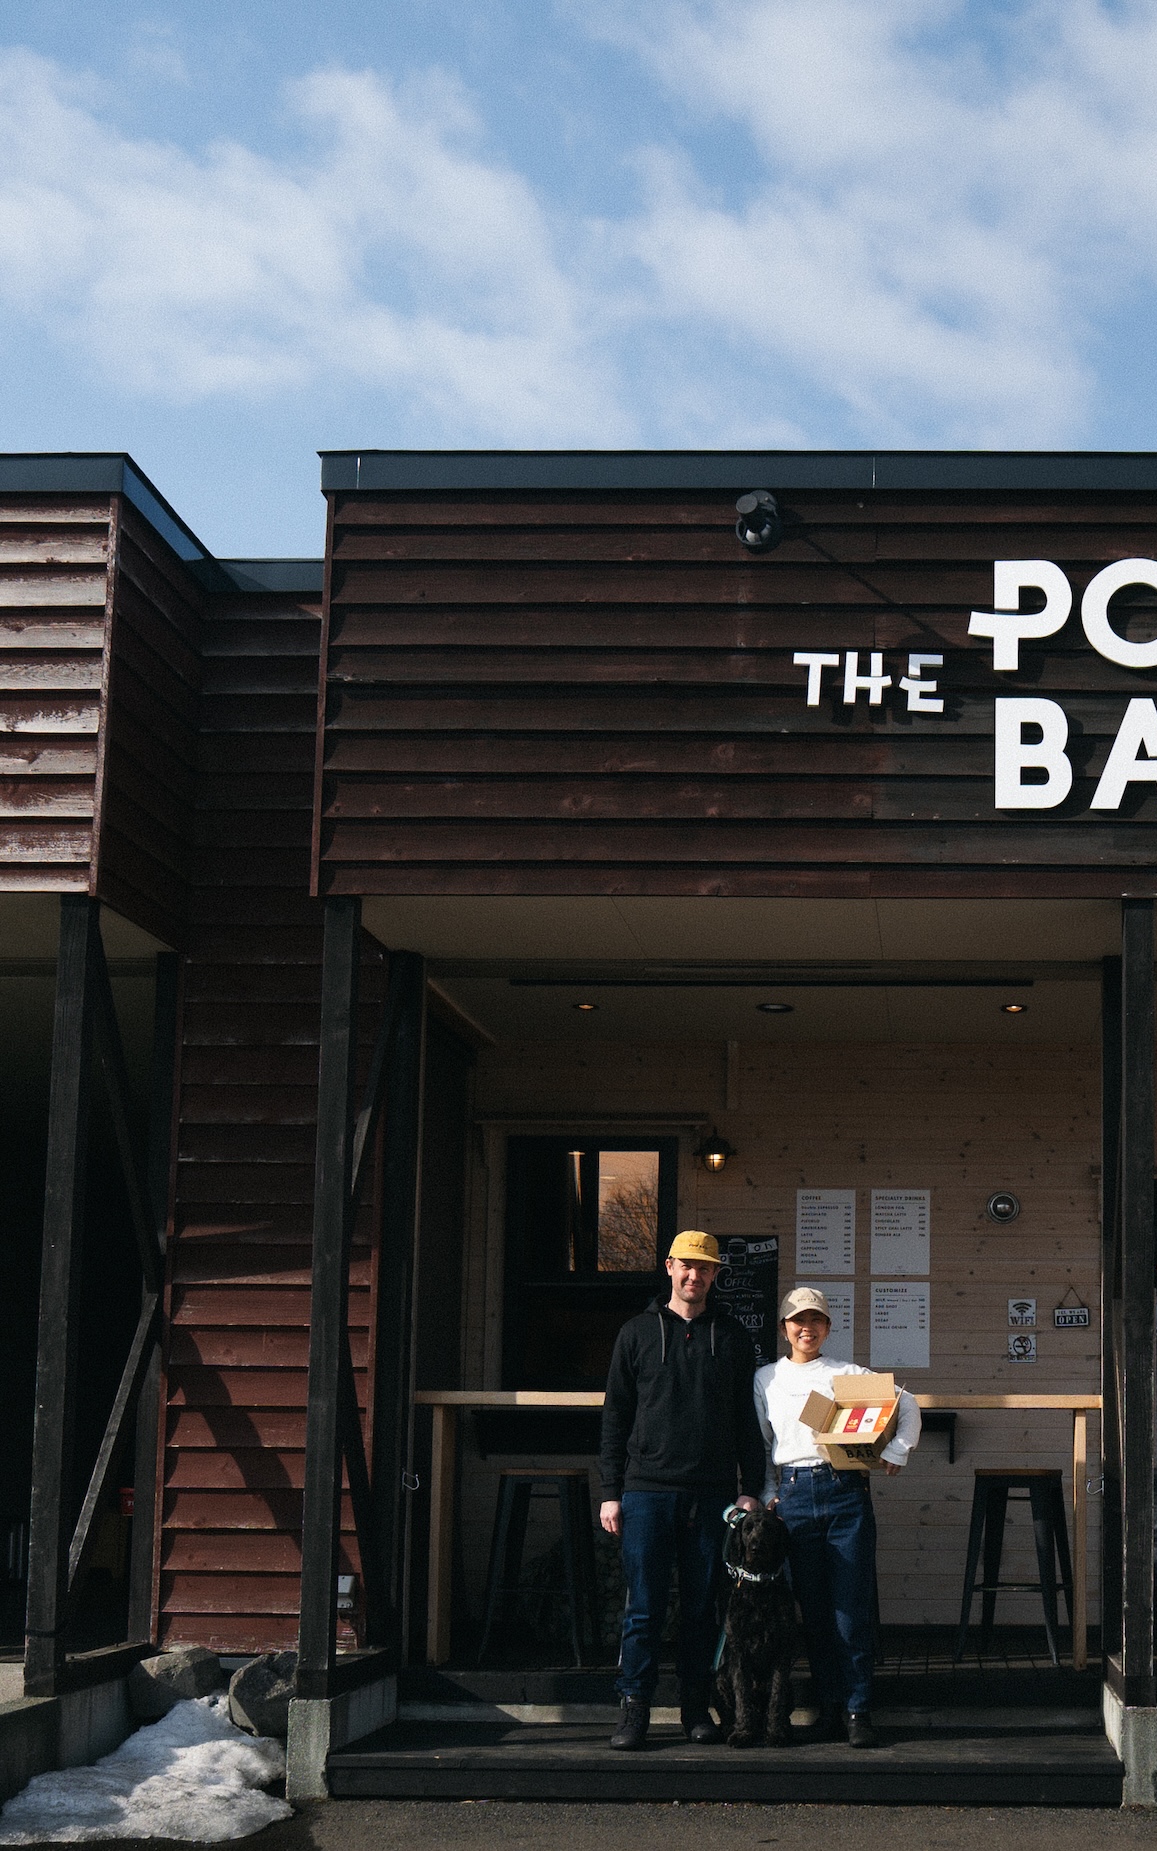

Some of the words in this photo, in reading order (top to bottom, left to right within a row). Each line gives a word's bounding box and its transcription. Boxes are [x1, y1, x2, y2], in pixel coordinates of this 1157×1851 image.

[793, 651, 945, 714] THE
[1058, 1315, 1085, 1324] OPEN
[845, 1450, 876, 1458] BAR
